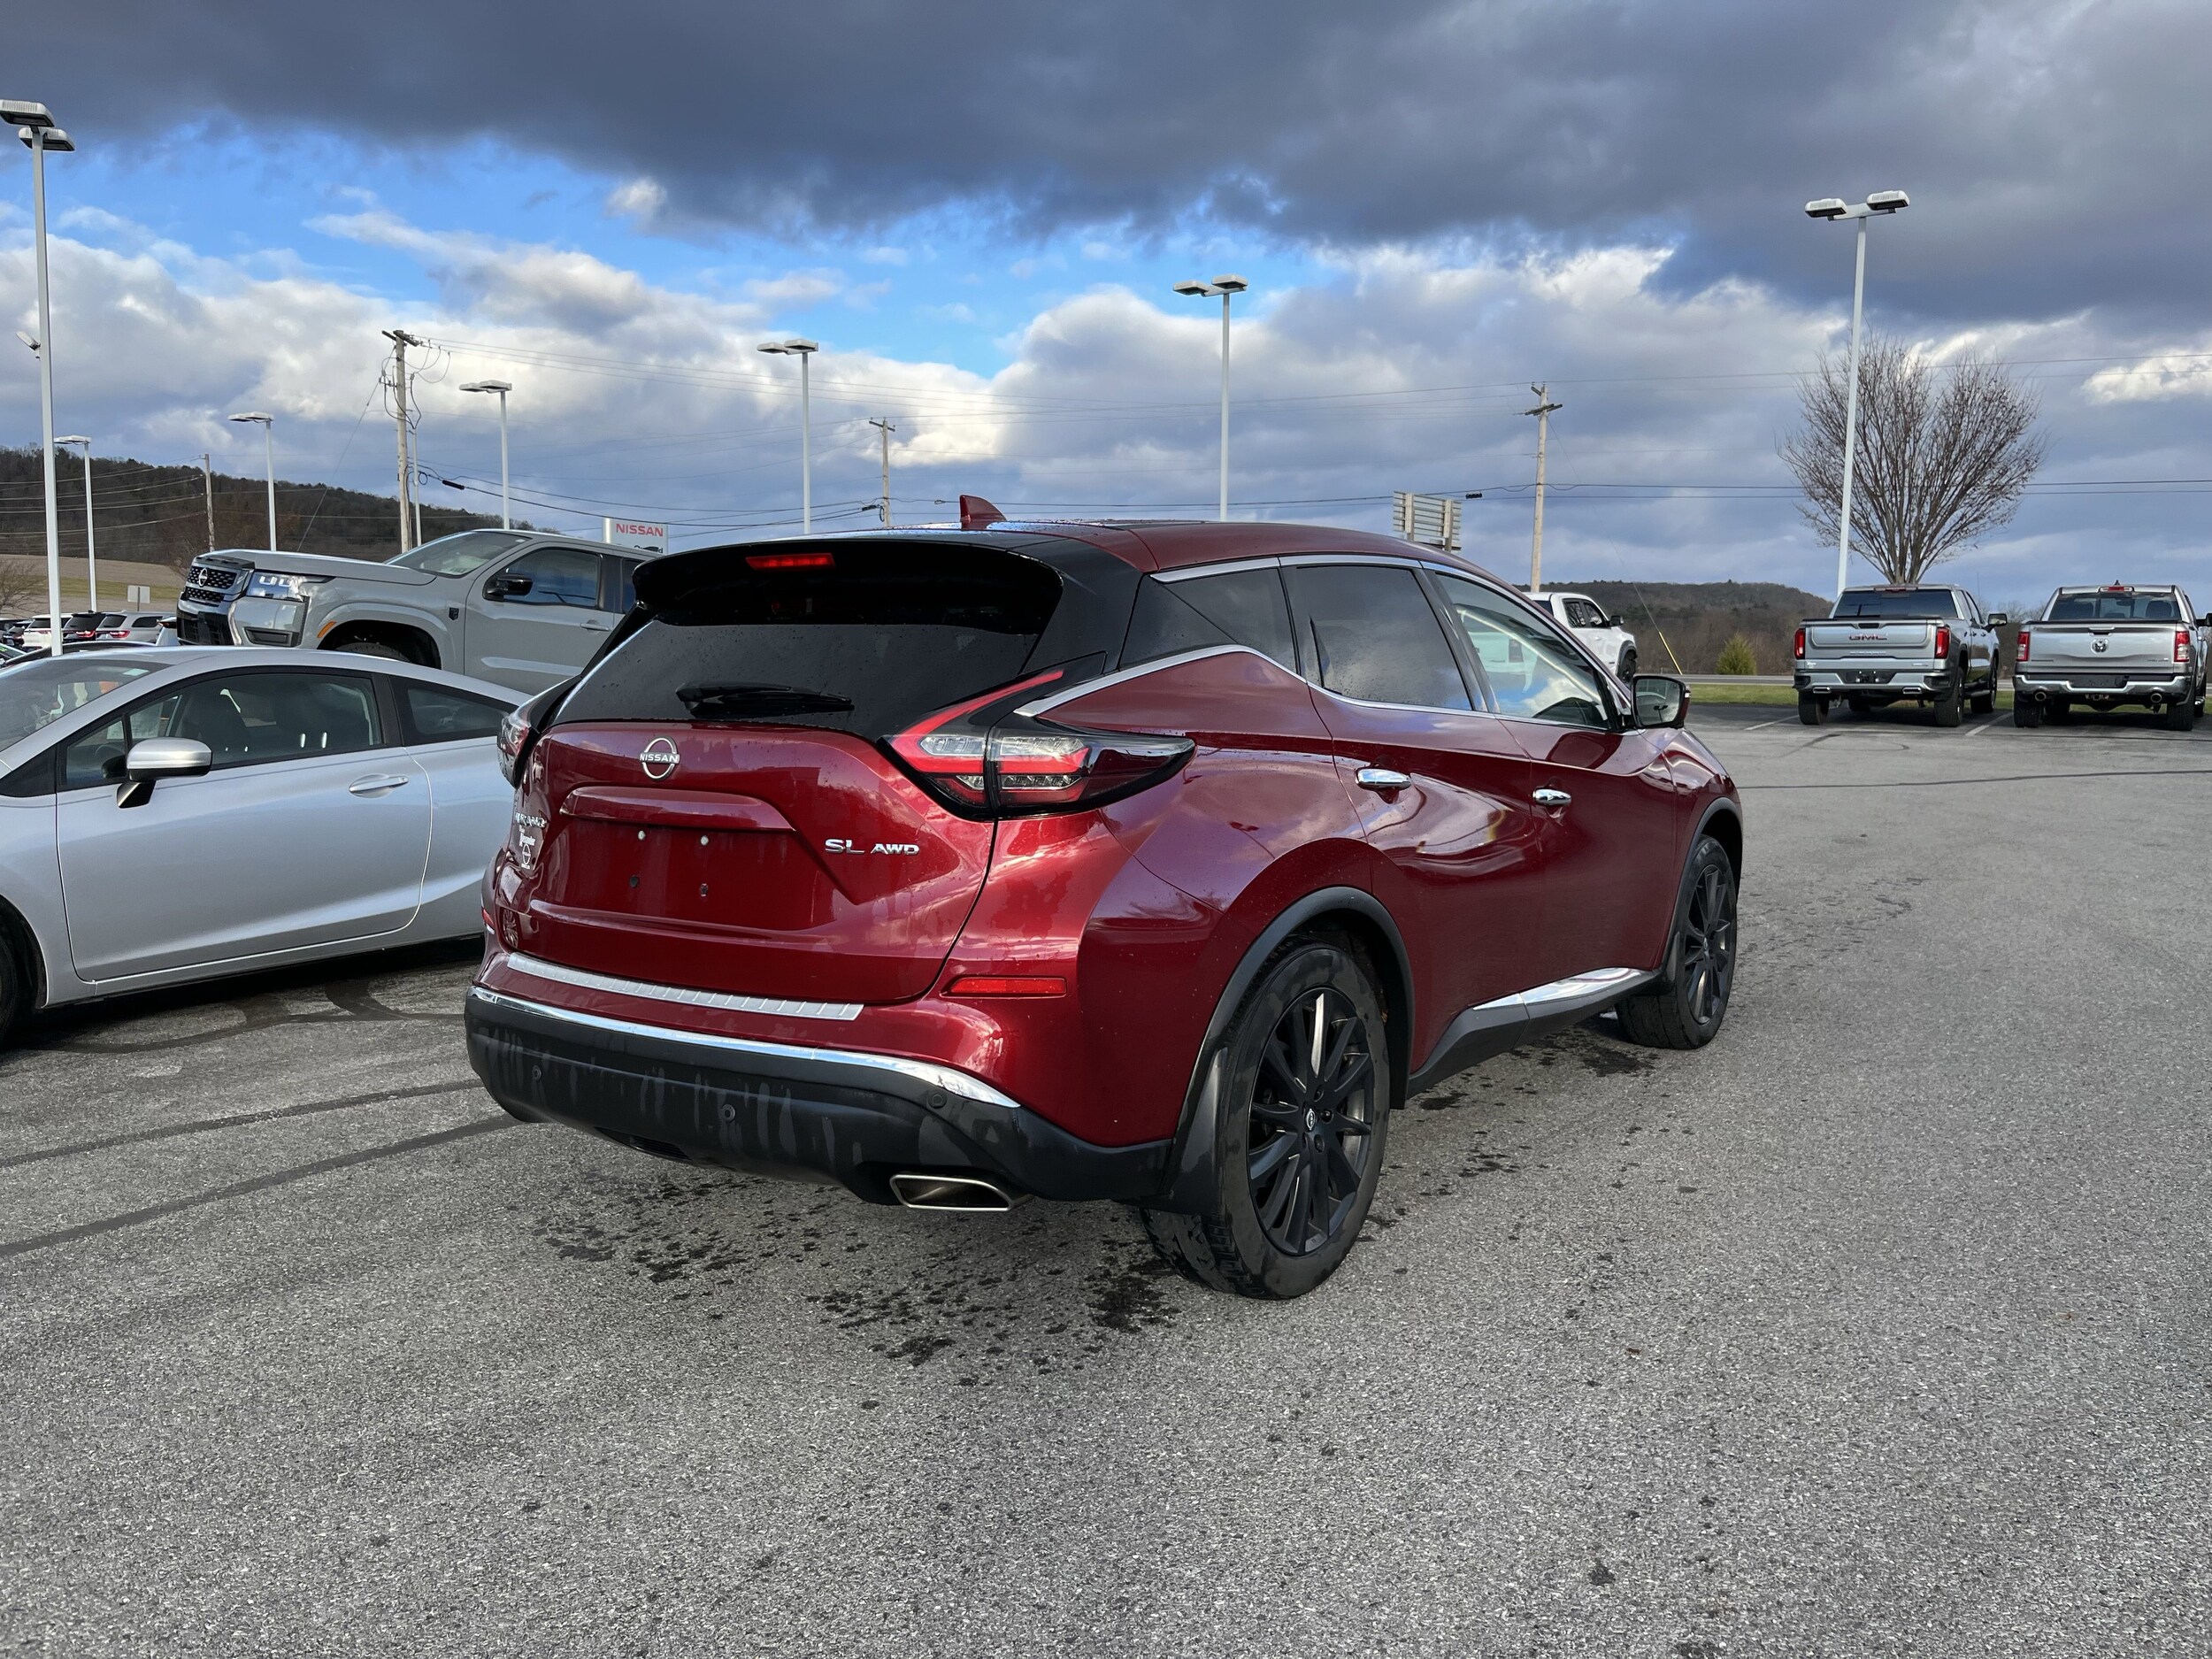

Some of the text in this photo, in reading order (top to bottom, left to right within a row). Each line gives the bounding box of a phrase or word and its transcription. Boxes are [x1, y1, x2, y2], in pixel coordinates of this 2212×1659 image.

[615, 523, 664, 537] NISSAN
[1848, 633, 1888, 641] GMC
[639, 752, 680, 764] NISSAN
[825, 838, 920, 856] SL AWD
